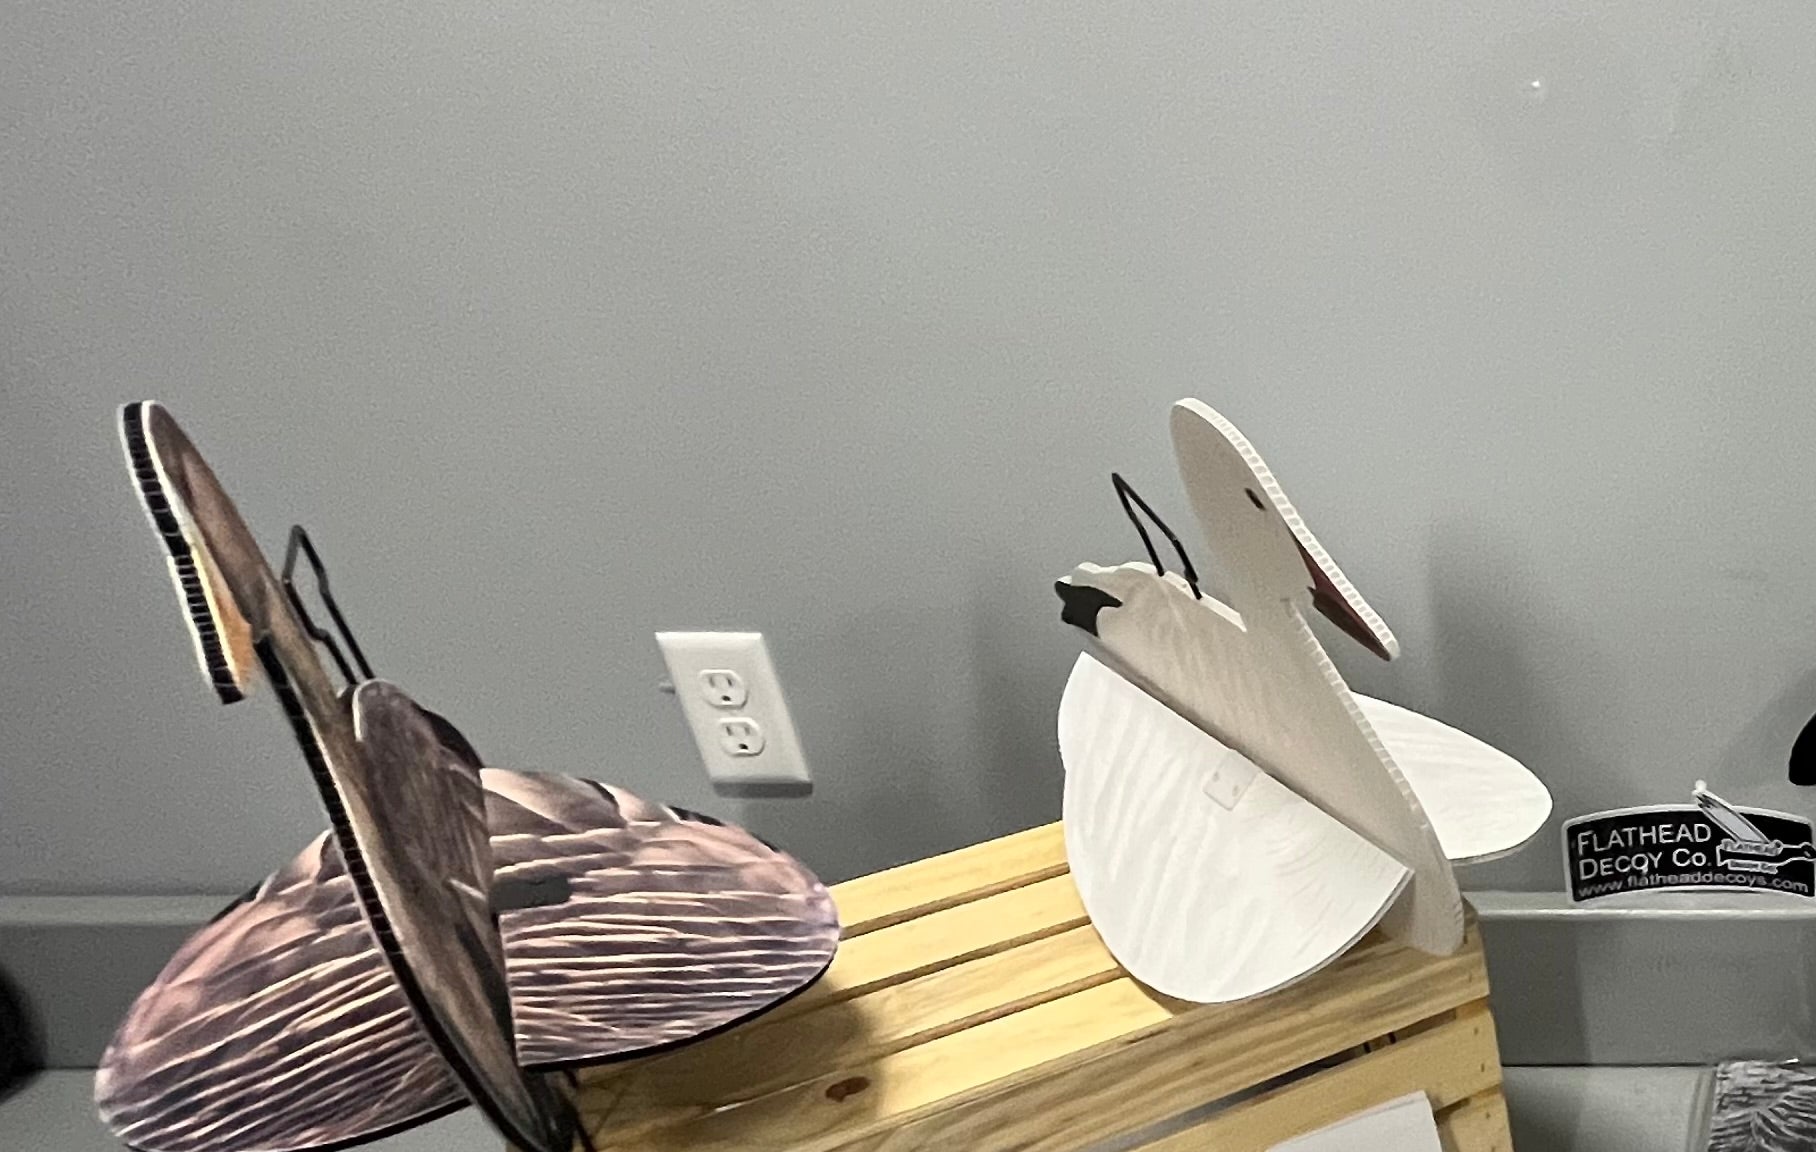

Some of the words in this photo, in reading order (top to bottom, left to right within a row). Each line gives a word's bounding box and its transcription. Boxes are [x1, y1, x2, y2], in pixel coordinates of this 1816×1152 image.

[1577, 823, 1712, 855] FLATHEAD
[1579, 851, 1663, 881] DECOY
[1578, 871, 1809, 897] www.flatheaddecoys.com
